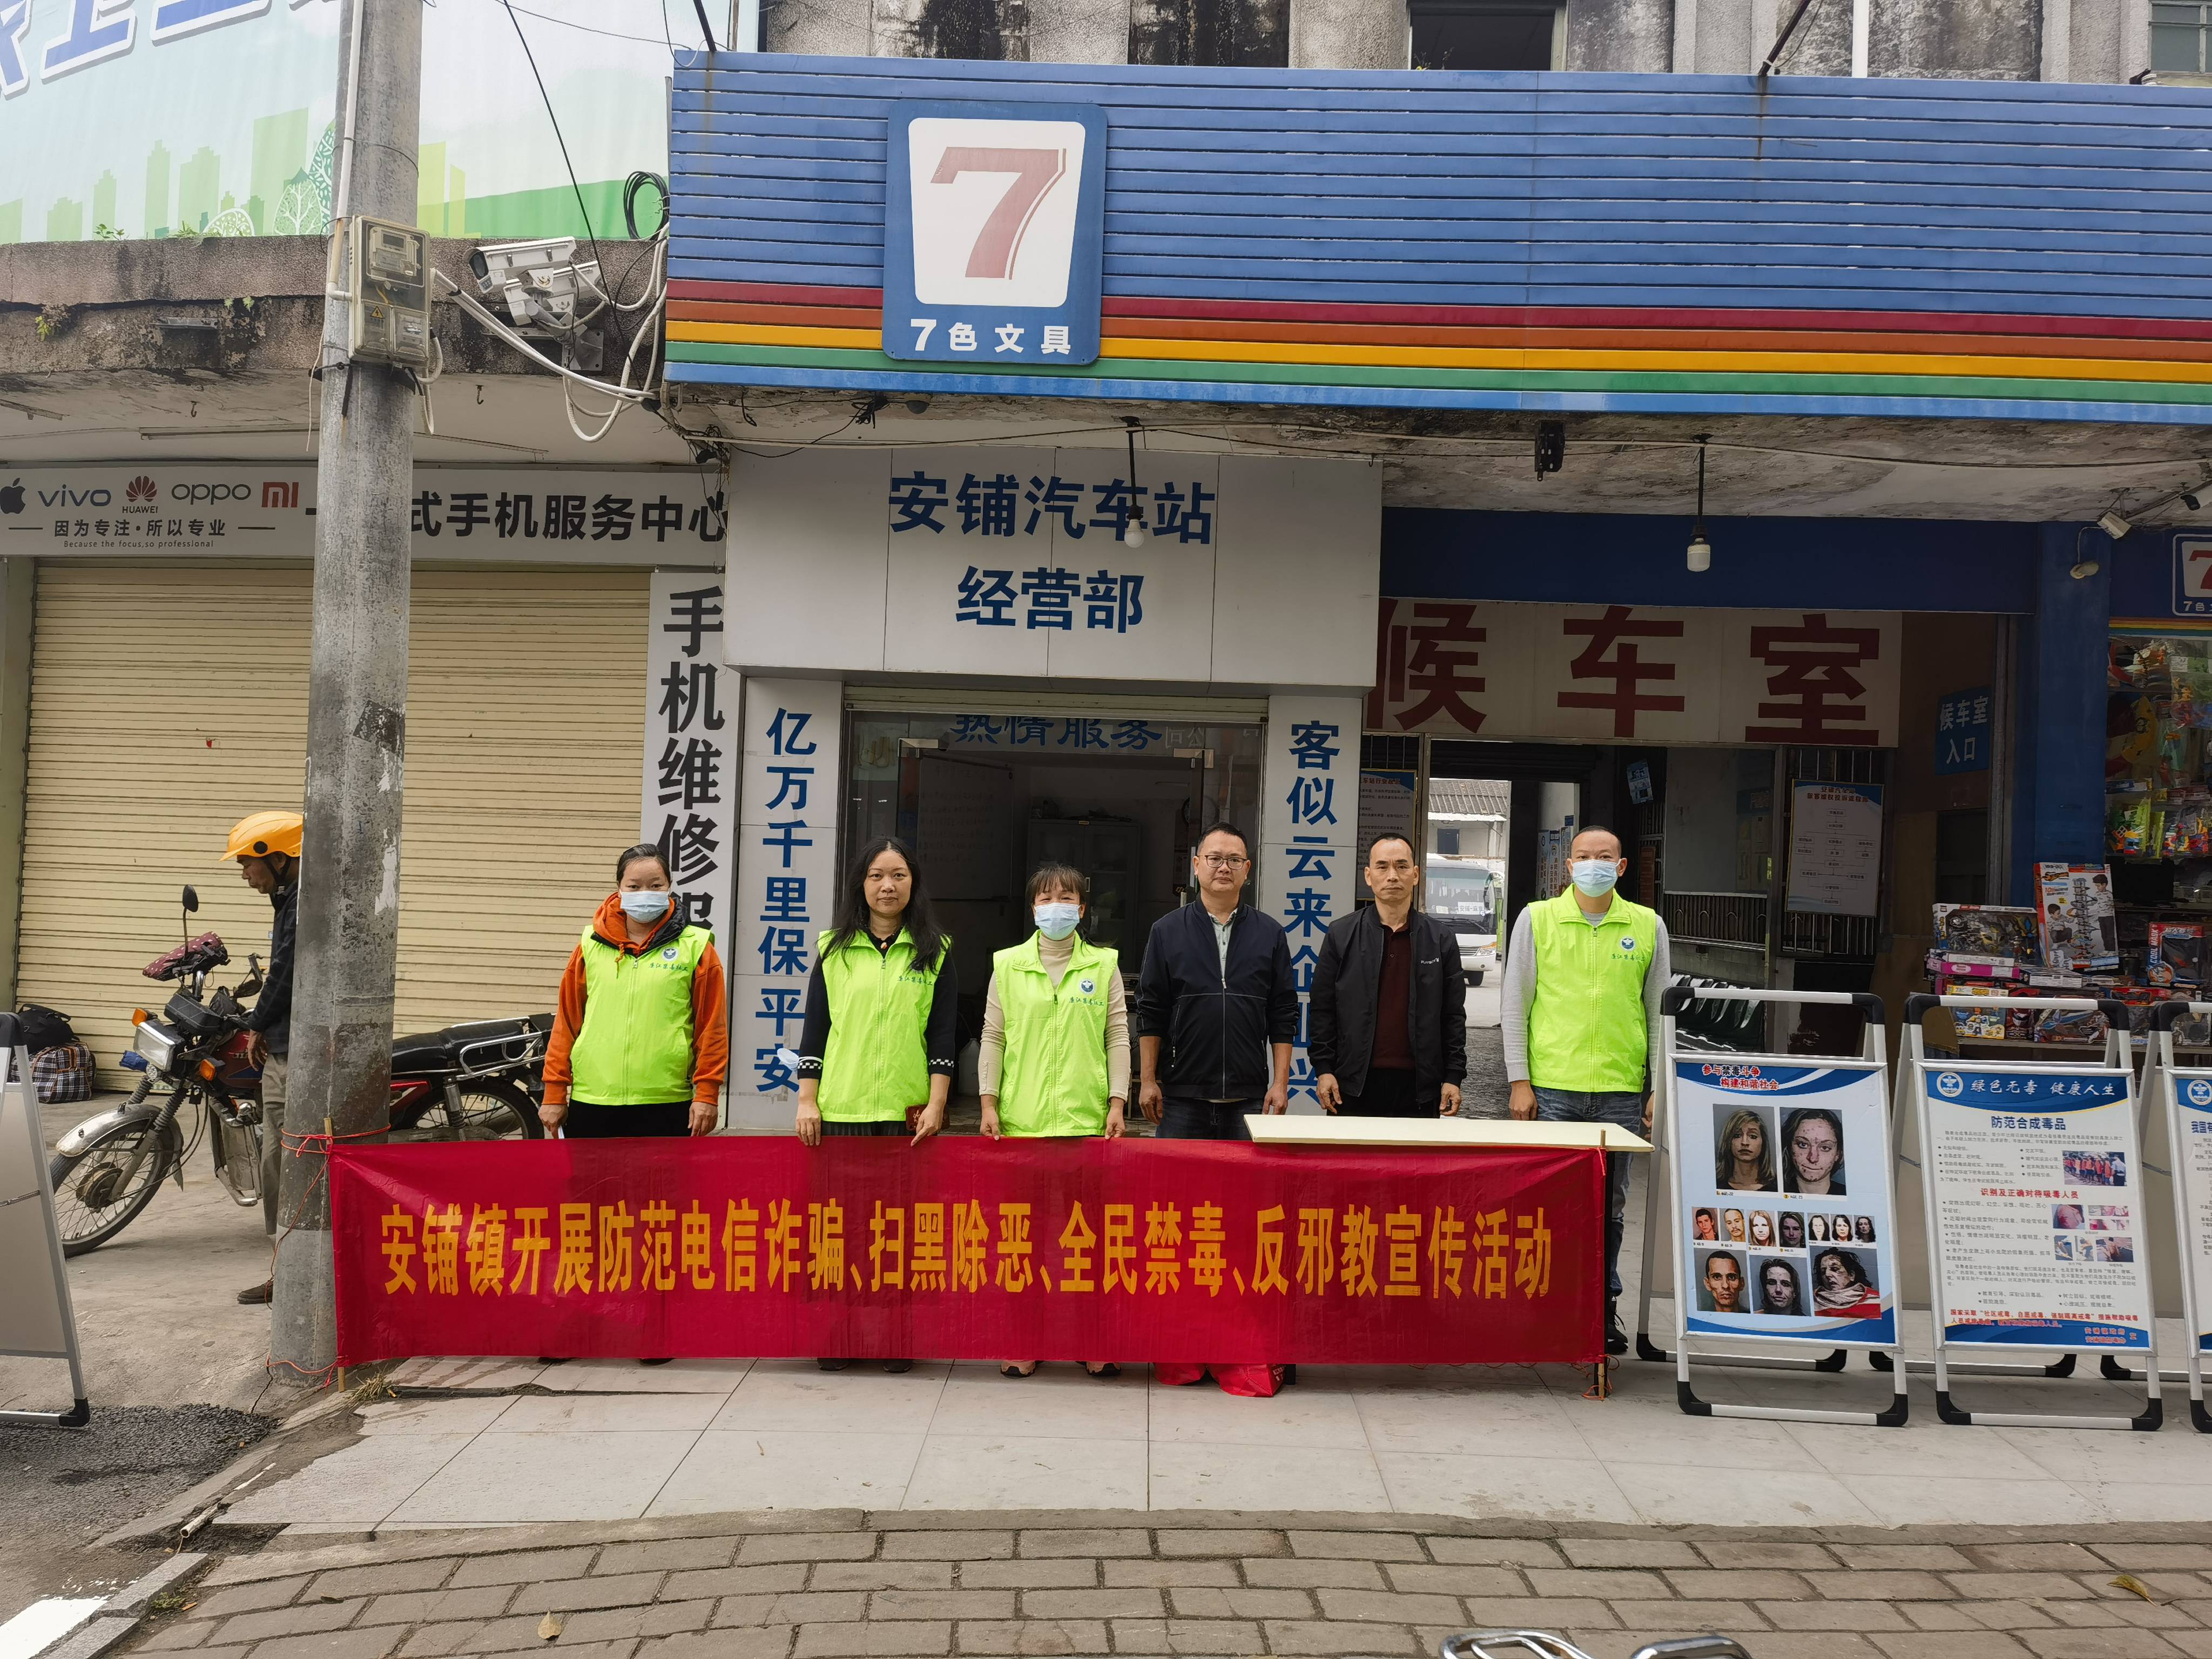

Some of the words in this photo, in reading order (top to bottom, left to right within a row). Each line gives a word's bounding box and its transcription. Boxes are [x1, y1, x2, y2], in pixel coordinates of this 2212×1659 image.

[930, 146, 1067, 280] 7
[911, 319, 1071, 355] 7色文具
[37, 483, 111, 508] vivo
[171, 483, 251, 504] oppo
[122, 505, 159, 514] HUAWEI
[889, 471, 1215, 544] 安铺汽车站
[956, 565, 1144, 633] 经营部
[2183, 601, 2212, 612] 7色
[1366, 598, 1880, 746] 候车室
[1940, 696, 1988, 732] 候车室
[949, 714, 1163, 750] 热情服务
[1946, 737, 1975, 764] 入口
[755, 707, 817, 1093] 亿万千里保平安
[1702, 1063, 1761, 1077] 参与禁毒斗争
[1720, 1077, 1780, 1090] 构建和谐社会
[1970, 1079, 2039, 1095] 绿色无毒
[2049, 1081, 2116, 1096] 健康人生
[1991, 1116, 2066, 1130] 防范合成毒品
[1980, 1188, 2079, 1199] 识别及正确对待吸毒人员
[381, 1197, 1552, 1300] 安铺镇开展防范电信诈骗、扫黑除恶、全民禁毒、反邪教宣传活动
